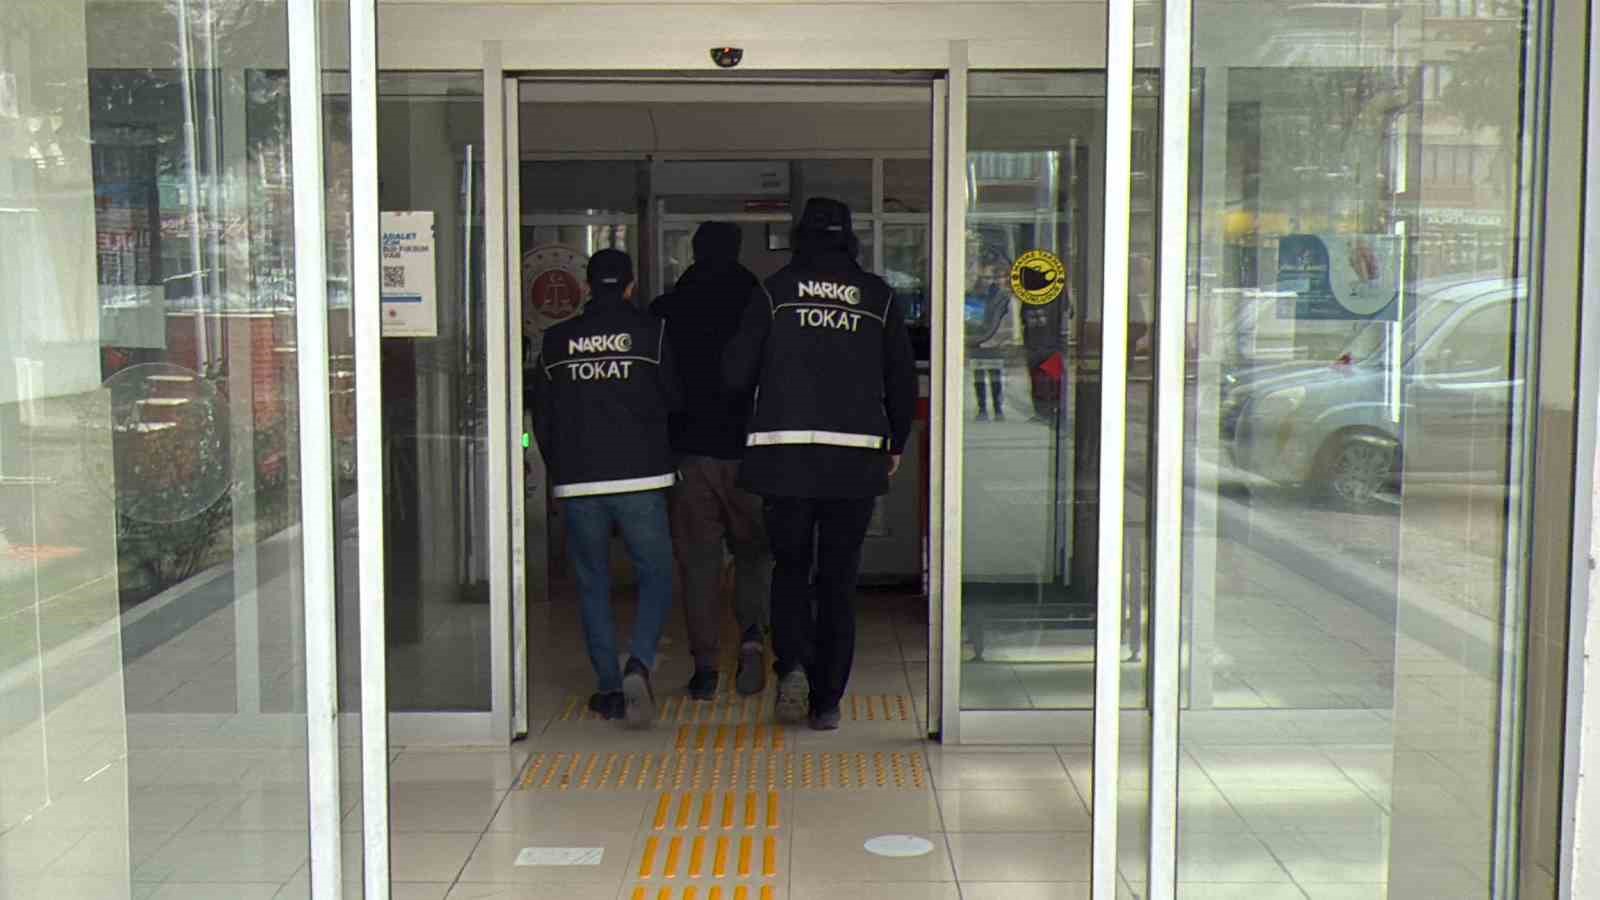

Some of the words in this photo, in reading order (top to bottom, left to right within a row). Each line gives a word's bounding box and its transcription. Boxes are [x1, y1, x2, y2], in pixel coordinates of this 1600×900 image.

[798, 280, 861, 305] NARKO
[796, 308, 861, 332] TOKAT
[568, 333, 632, 355] NARKO
[568, 360, 632, 381] TOKAT
